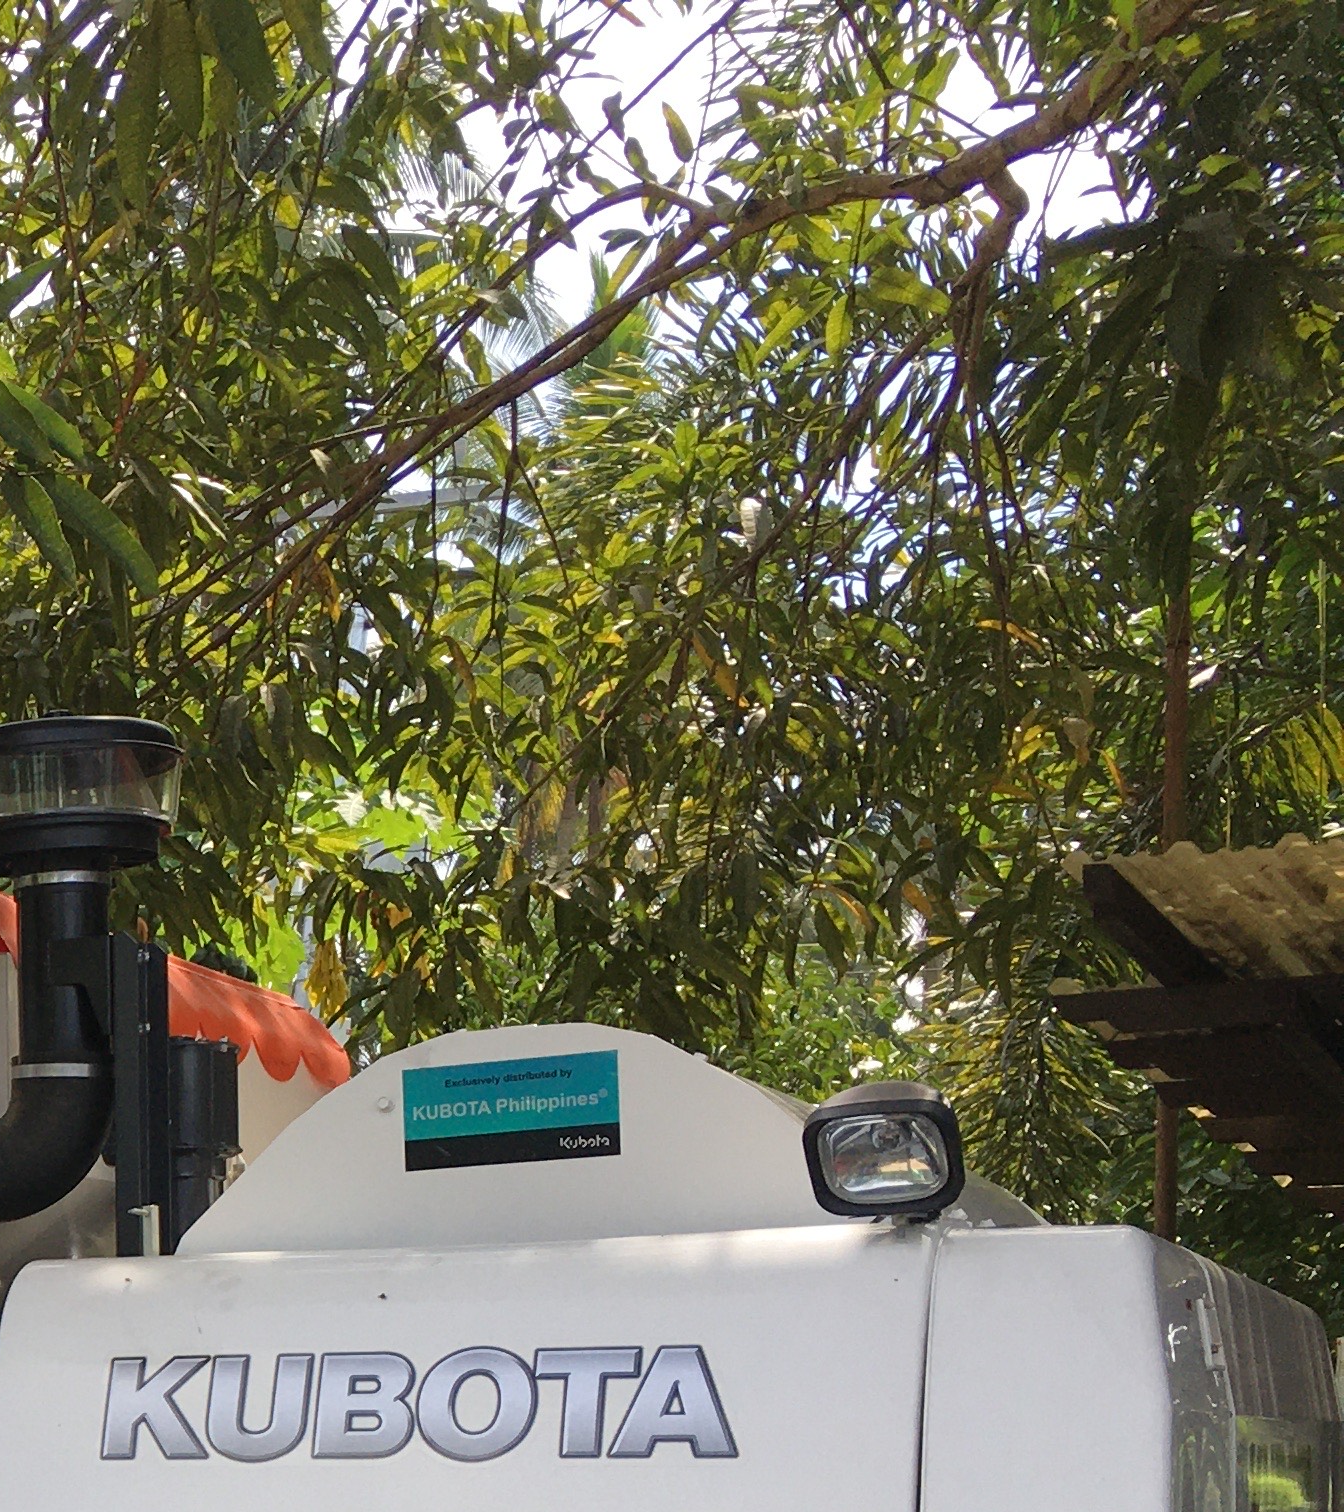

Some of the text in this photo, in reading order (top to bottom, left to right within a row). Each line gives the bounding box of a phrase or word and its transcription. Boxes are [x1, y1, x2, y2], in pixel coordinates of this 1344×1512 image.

[444, 1068, 573, 1089] Exclusively distributed by
[412, 1099, 492, 1121] KUBOTA
[559, 1136, 611, 1150] Kubota
[99, 1344, 740, 1464] KUBOTA
